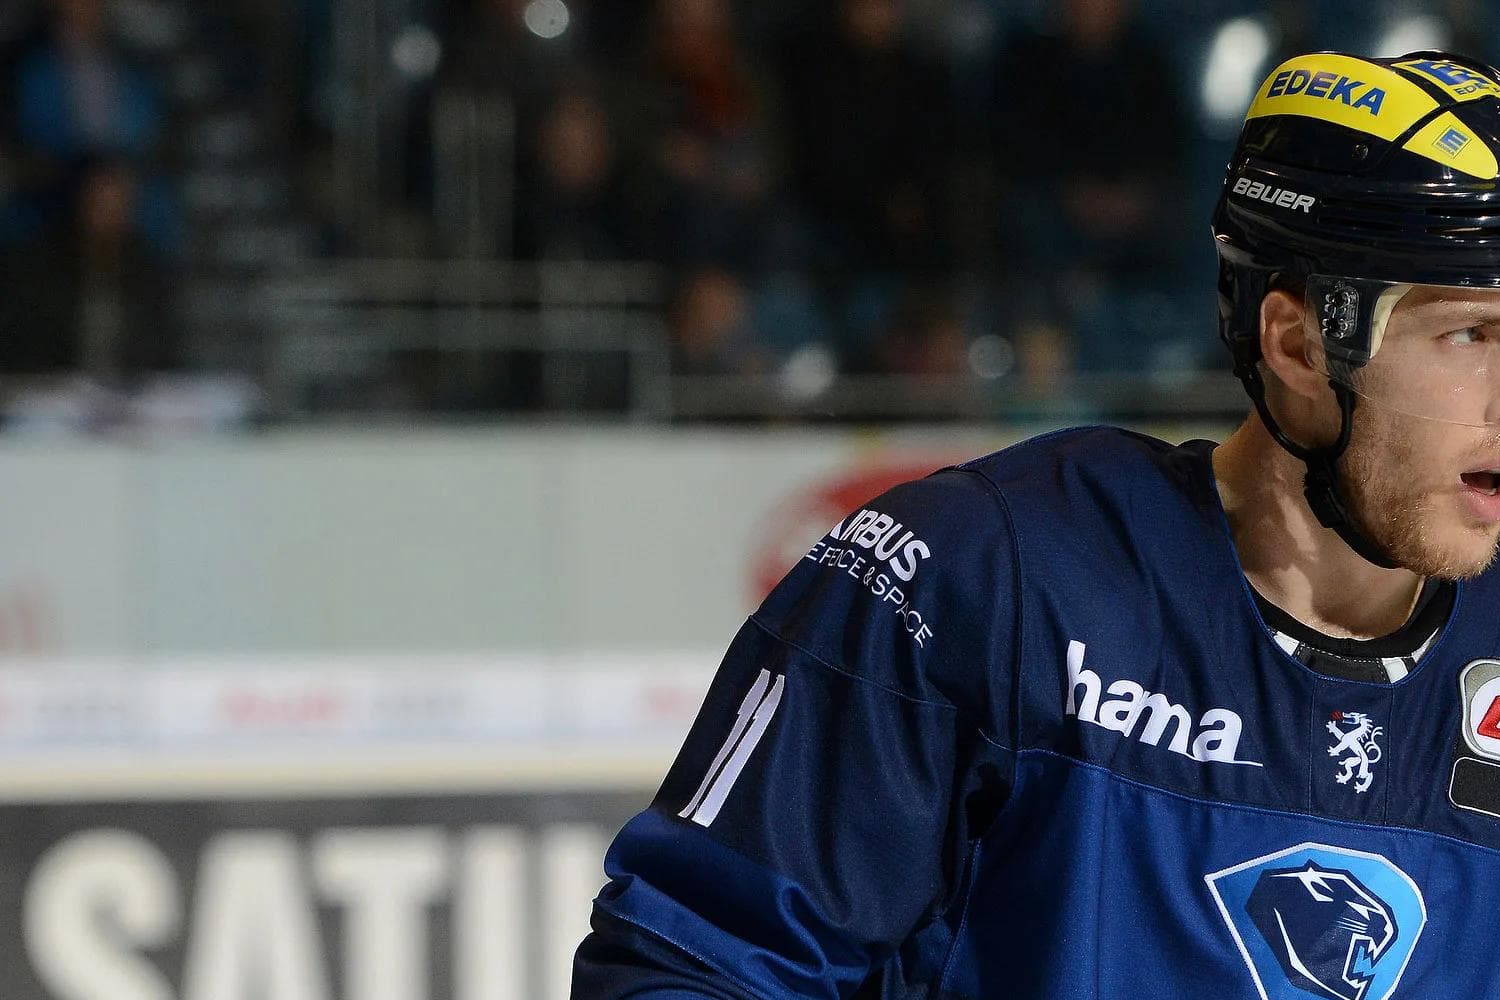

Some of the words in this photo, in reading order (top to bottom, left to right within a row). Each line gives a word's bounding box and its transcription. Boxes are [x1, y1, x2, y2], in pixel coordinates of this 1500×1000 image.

[1267, 69, 1386, 116] EDEKA
[1232, 177, 1315, 213] BAUER
[805, 542, 867, 579] EFENCE
[863, 566, 876, 586] &
[871, 573, 934, 649] SPACE
[678, 668, 785, 828] 11
[1066, 640, 1250, 764] hama
